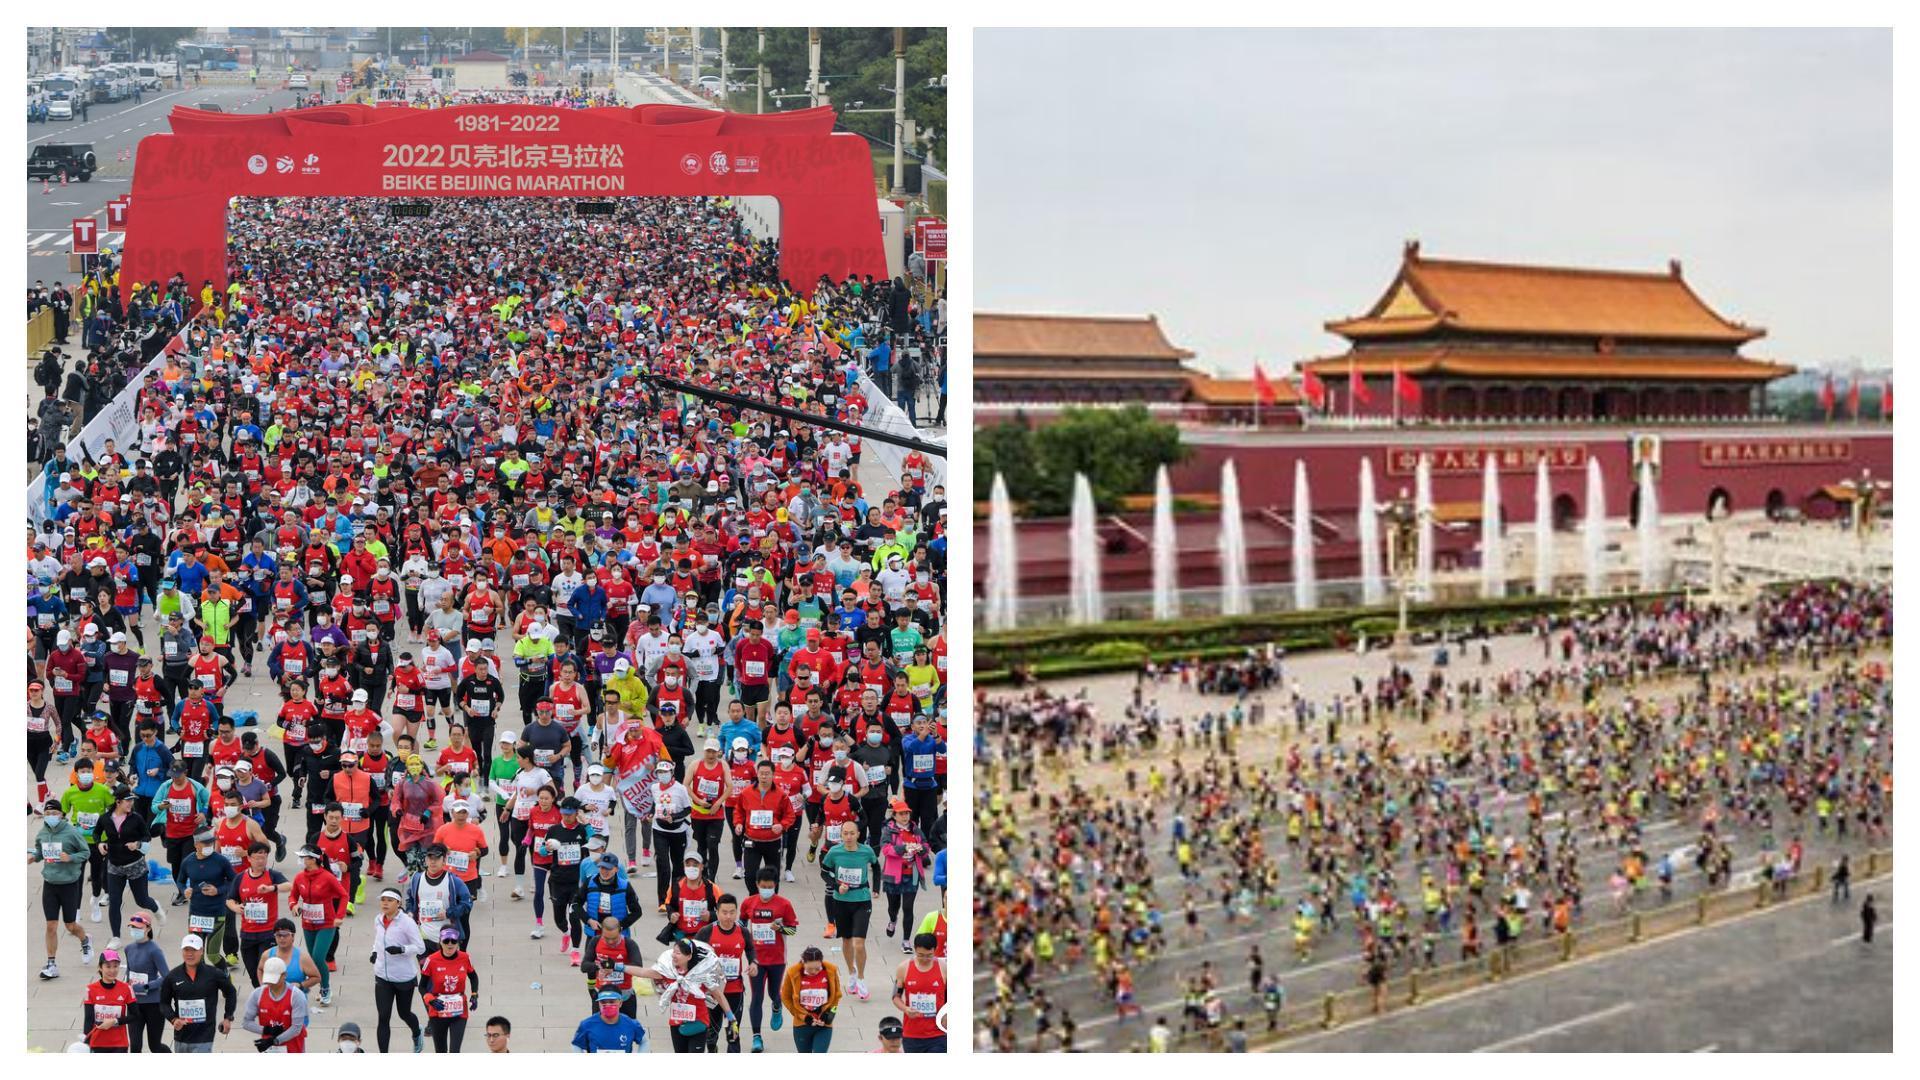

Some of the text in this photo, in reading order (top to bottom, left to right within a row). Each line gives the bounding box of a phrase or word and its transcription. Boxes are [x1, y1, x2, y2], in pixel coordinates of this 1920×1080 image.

[382, 175, 625, 191] BEIKE BEIJING MARATHON
[109, 203, 127, 222] T
[75, 221, 94, 241] T
[181, 1007, 204, 1017] D0052
